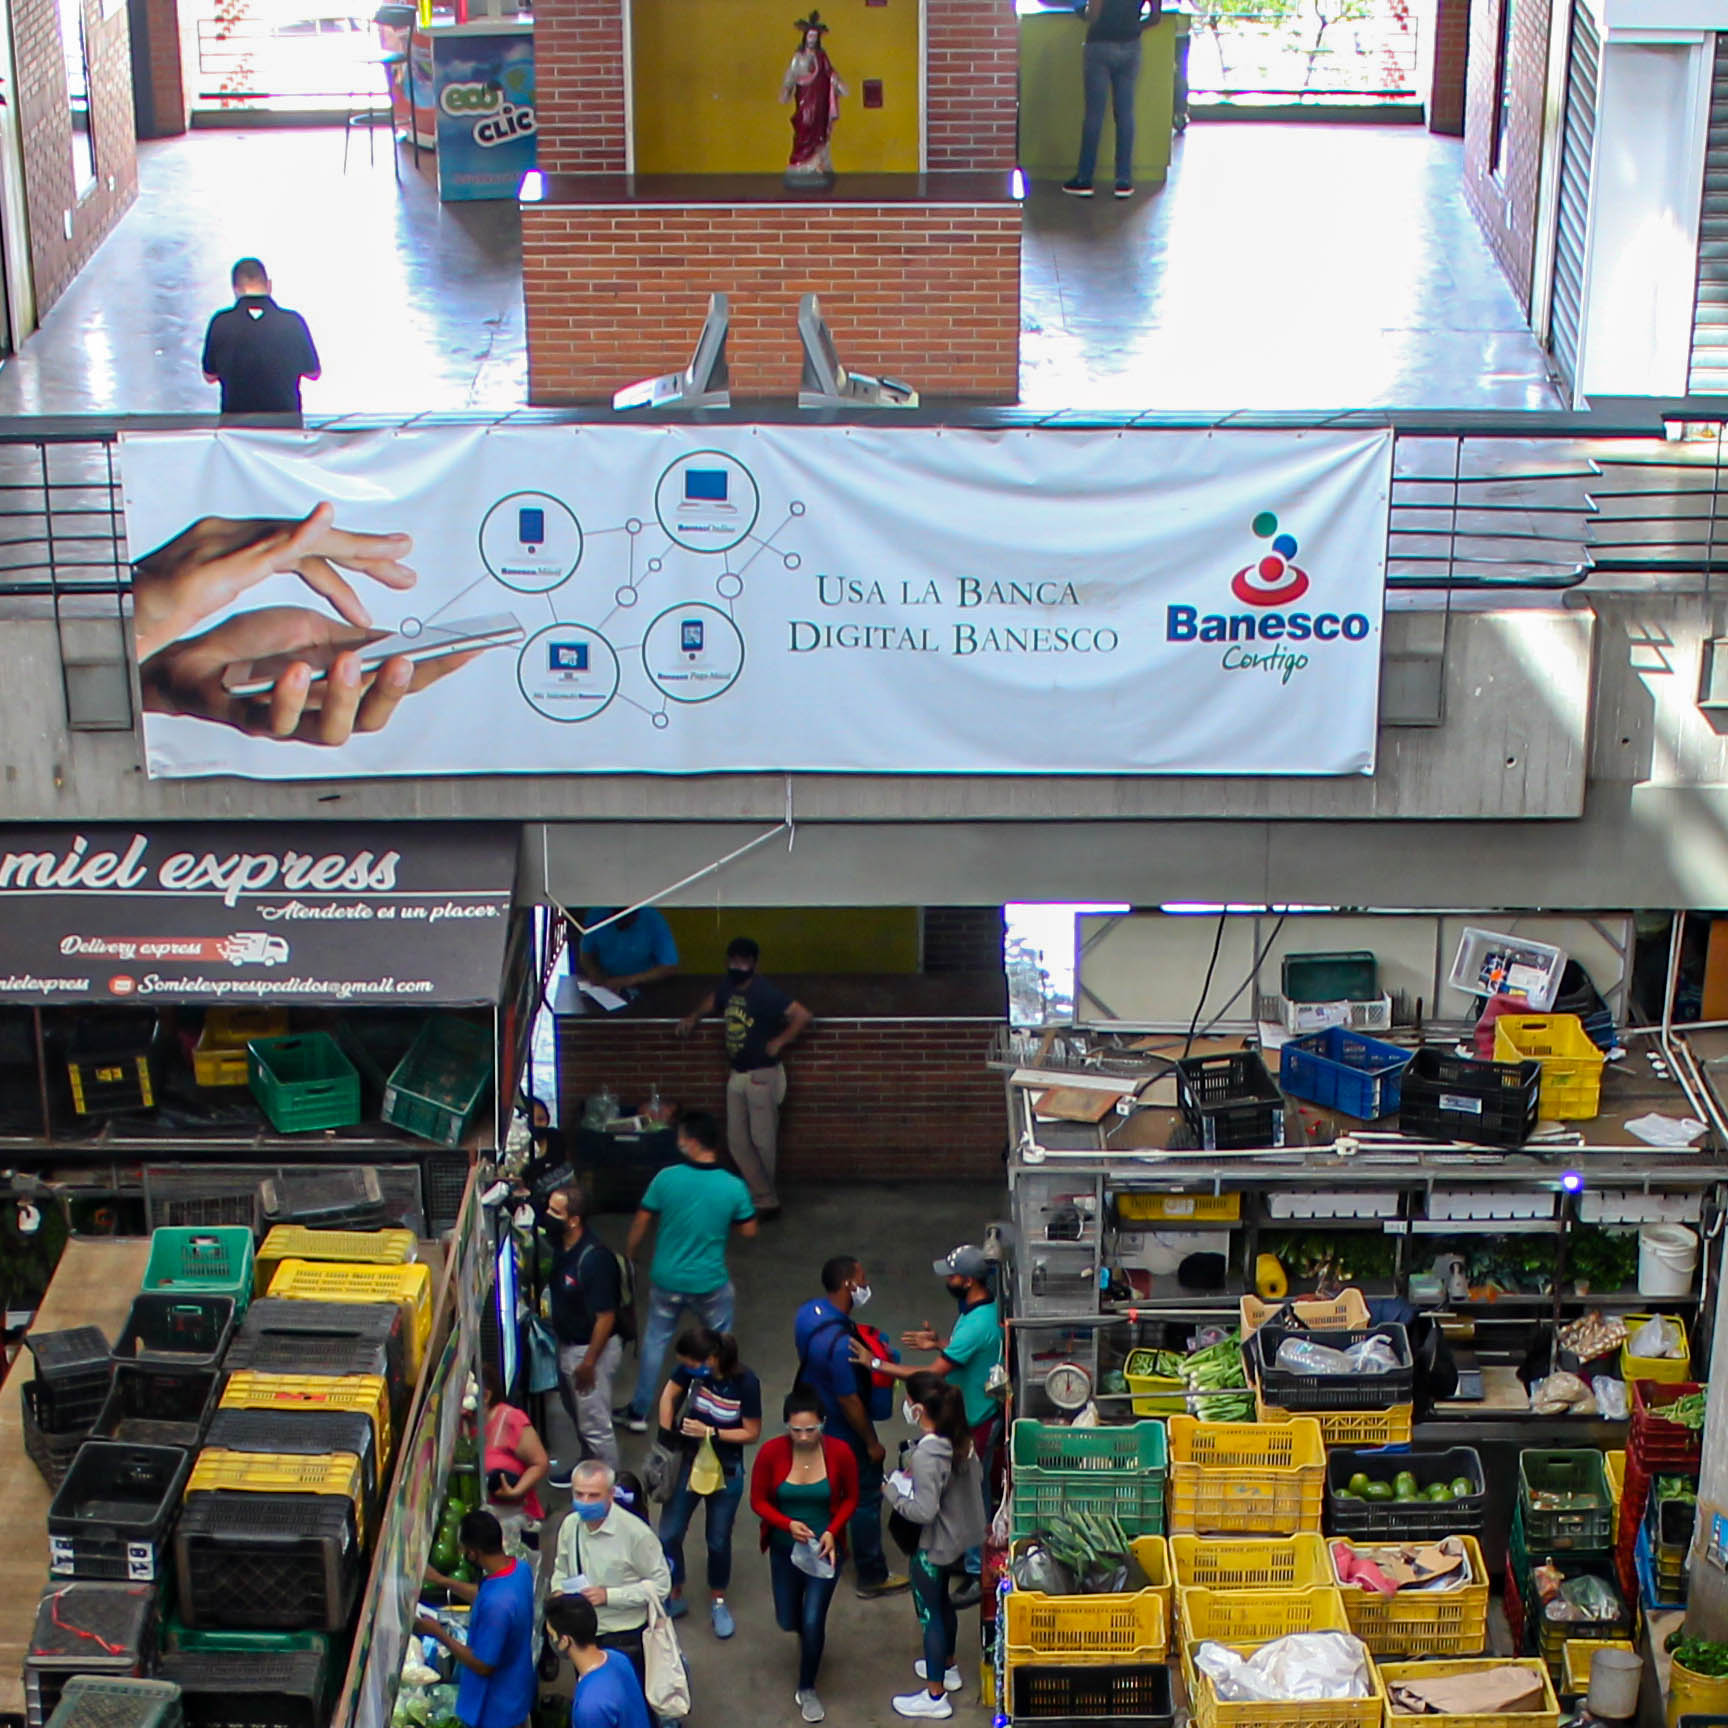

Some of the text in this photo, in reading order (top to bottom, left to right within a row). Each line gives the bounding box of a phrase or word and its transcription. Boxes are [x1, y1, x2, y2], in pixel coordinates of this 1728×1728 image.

[1166, 604, 1370, 642] Banesco
[1221, 642, 1309, 686] Contigo
[158, 850, 401, 907] express
[377, 907, 395, 919] es
[400, 906, 427, 919] un
[60, 935, 202, 960] Delivery express
